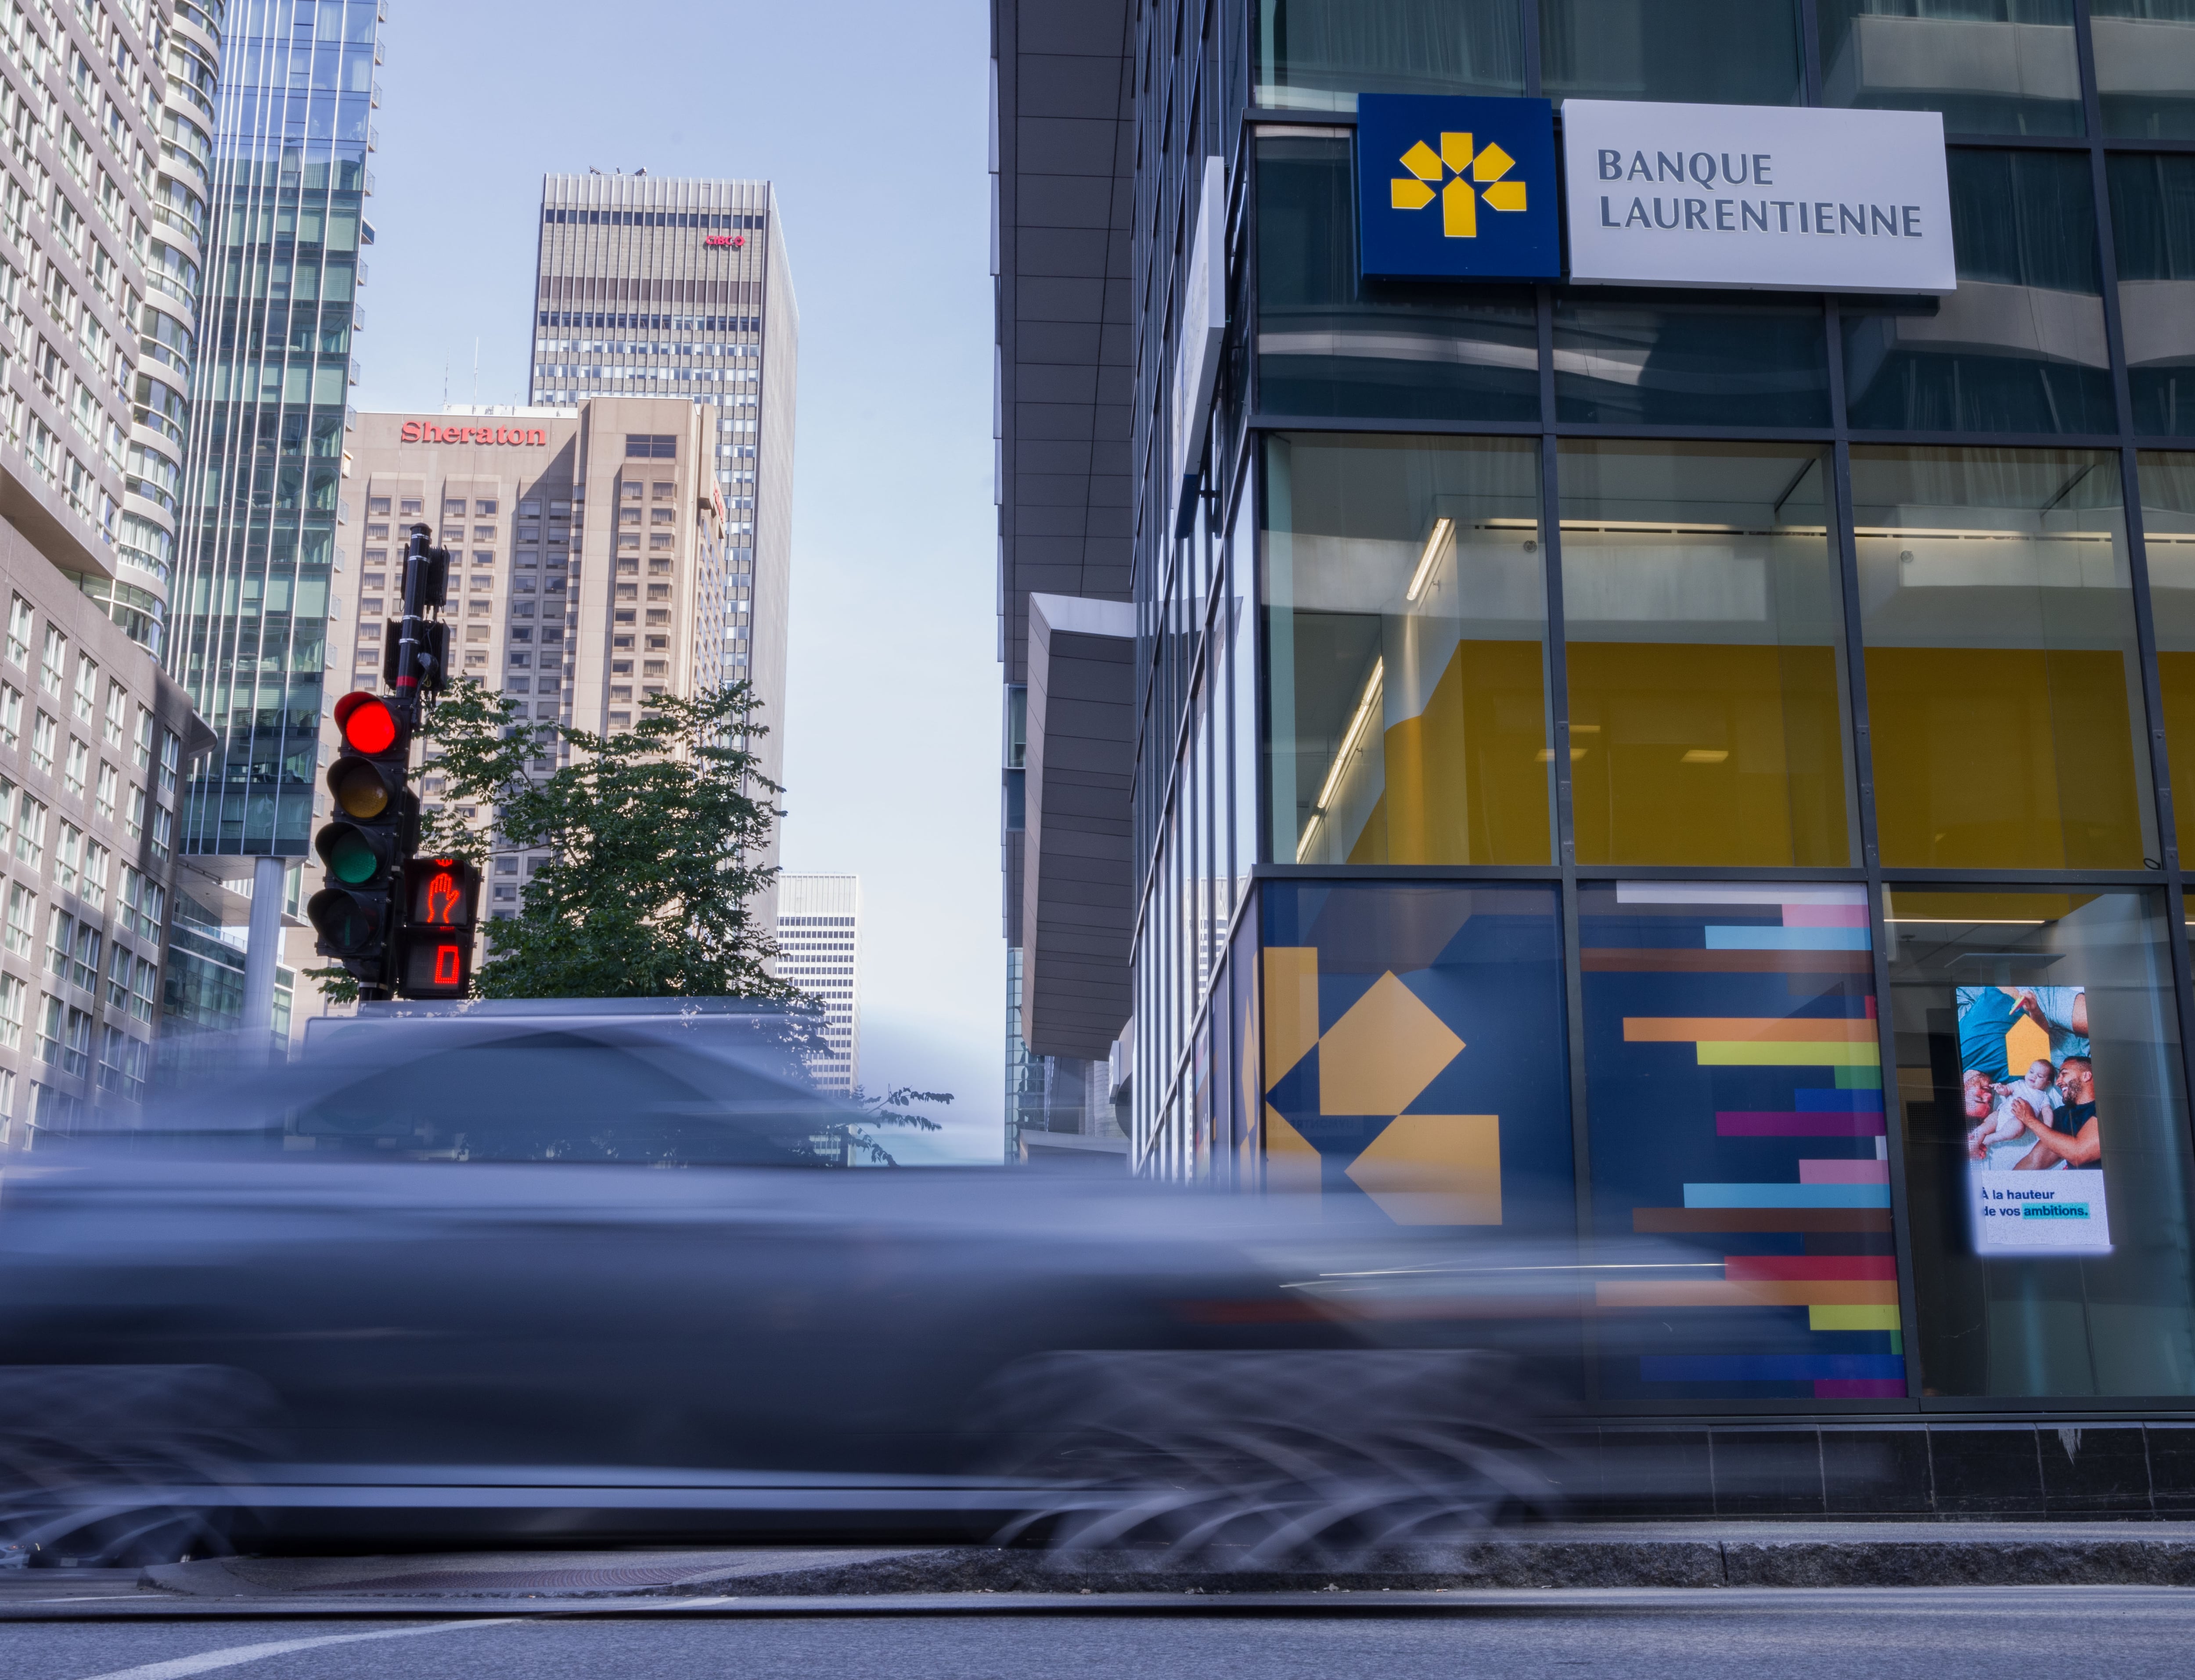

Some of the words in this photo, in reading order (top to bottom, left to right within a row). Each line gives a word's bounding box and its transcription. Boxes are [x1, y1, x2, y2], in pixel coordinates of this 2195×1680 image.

[1597, 148, 1773, 191] BANQUE
[1600, 196, 1923, 238] LAURENTIENNE
[705, 235, 733, 246] CIBC
[401, 420, 546, 445] Sheraton
[435, 945, 460, 984] 0
[1993, 1190, 2004, 1199] la
[2006, 1190, 2055, 1199] hauteur
[1984, 1206, 1996, 1216] de
[1999, 1208, 2021, 1216] vos
[2024, 1205, 2088, 1216] ambitions.
